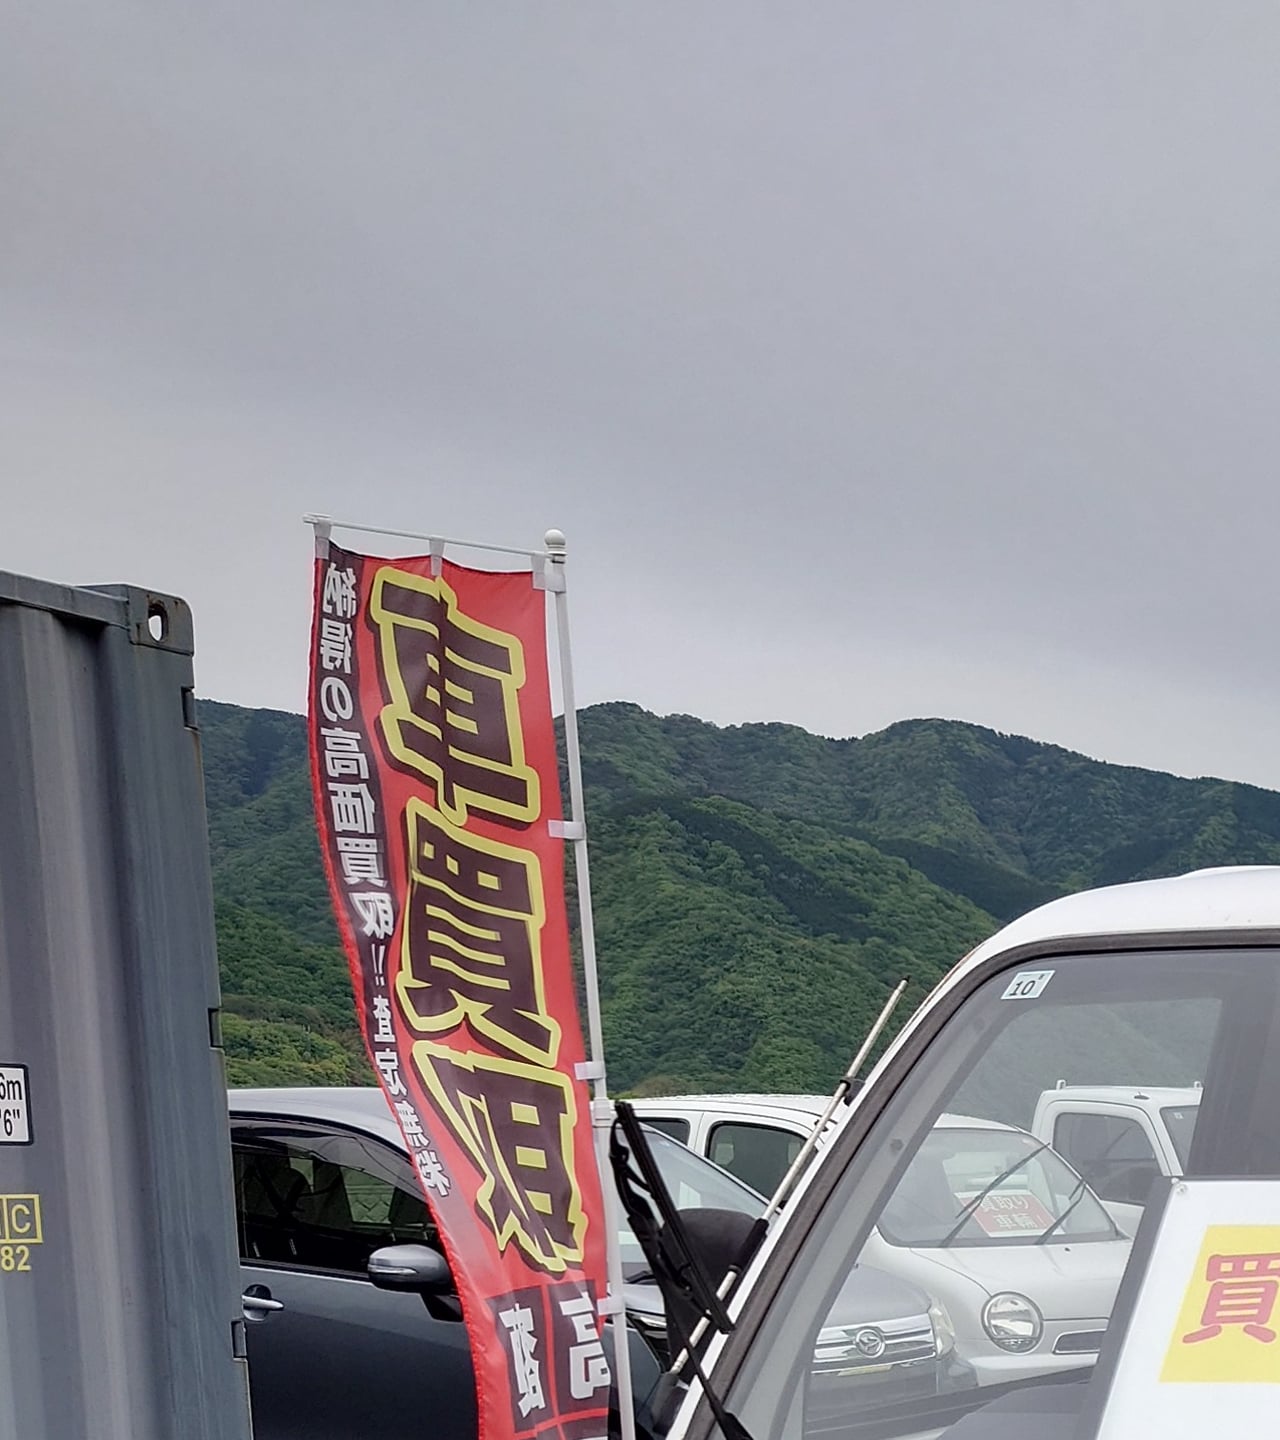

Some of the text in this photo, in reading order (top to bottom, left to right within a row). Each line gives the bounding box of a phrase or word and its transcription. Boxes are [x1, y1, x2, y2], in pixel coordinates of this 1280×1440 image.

[1009, 980, 1036, 996] 10
[11, 1204, 31, 1233] C
[1, 1245, 32, 1272] 82
